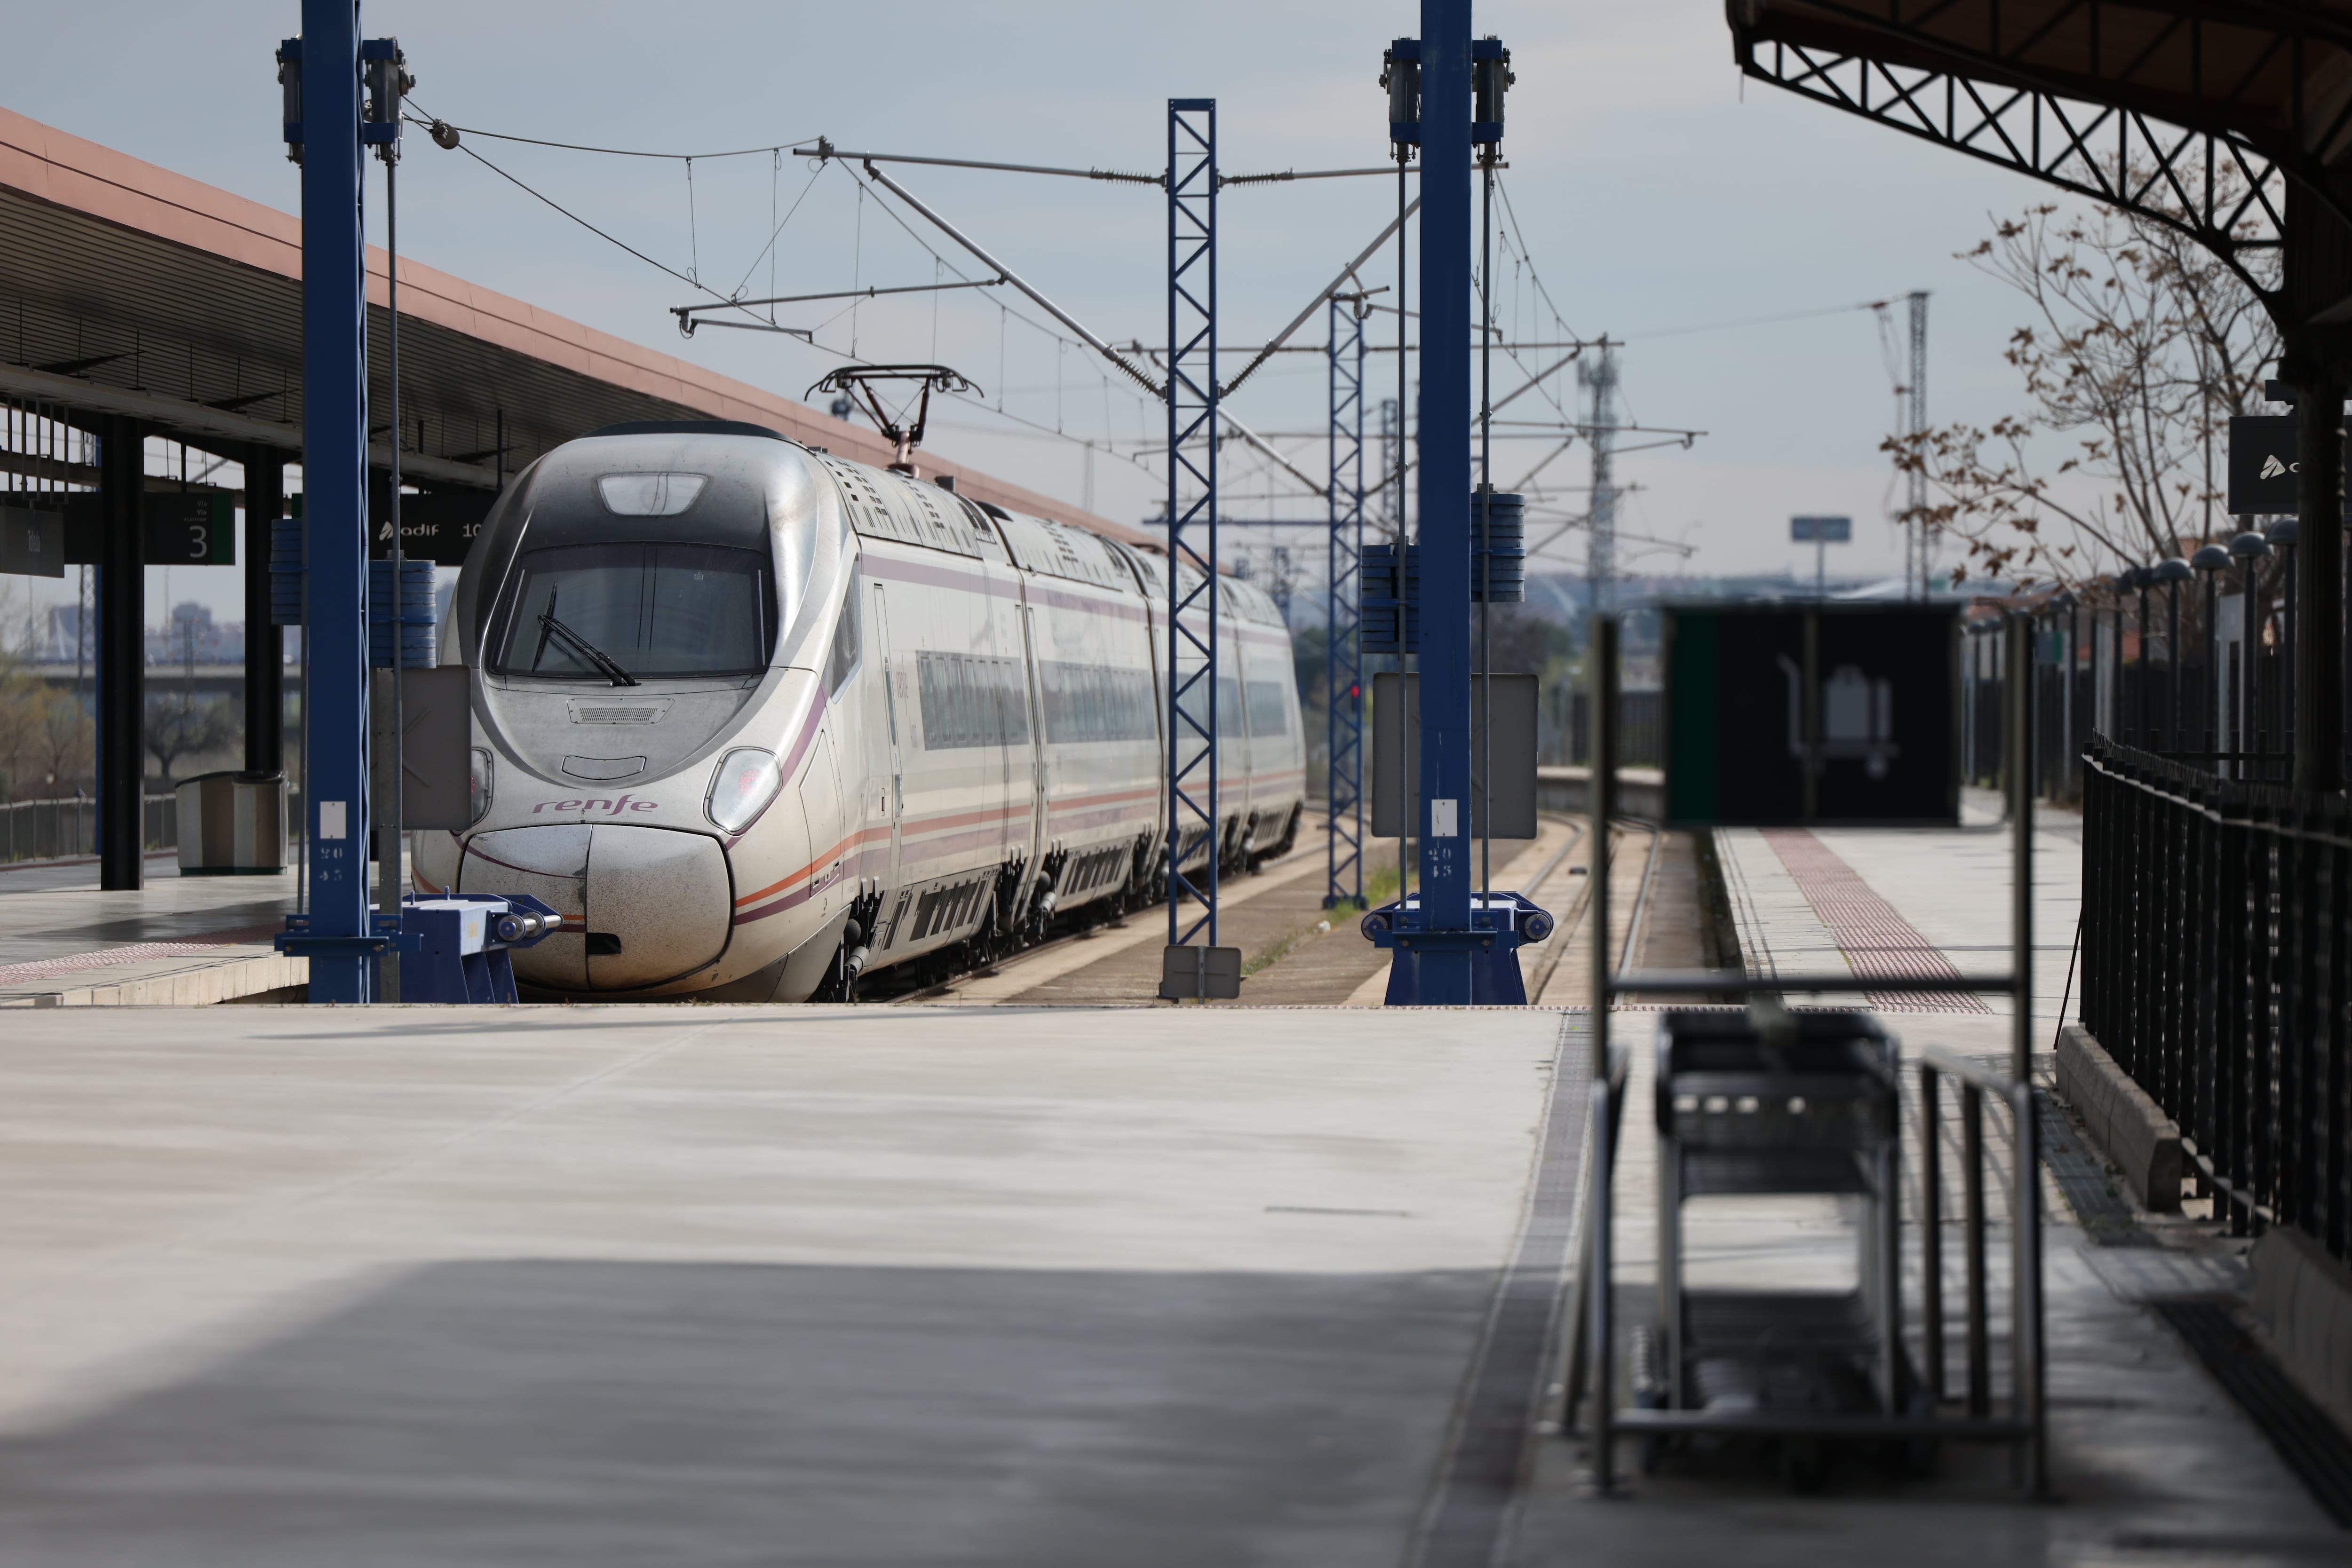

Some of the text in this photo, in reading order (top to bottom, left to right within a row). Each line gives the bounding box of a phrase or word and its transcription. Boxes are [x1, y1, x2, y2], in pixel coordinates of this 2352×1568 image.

[400, 523, 440, 536] adif
[28, 530, 40, 554] Toledo
[190, 525, 207, 558] 3
[532, 794, 659, 816] renfe
